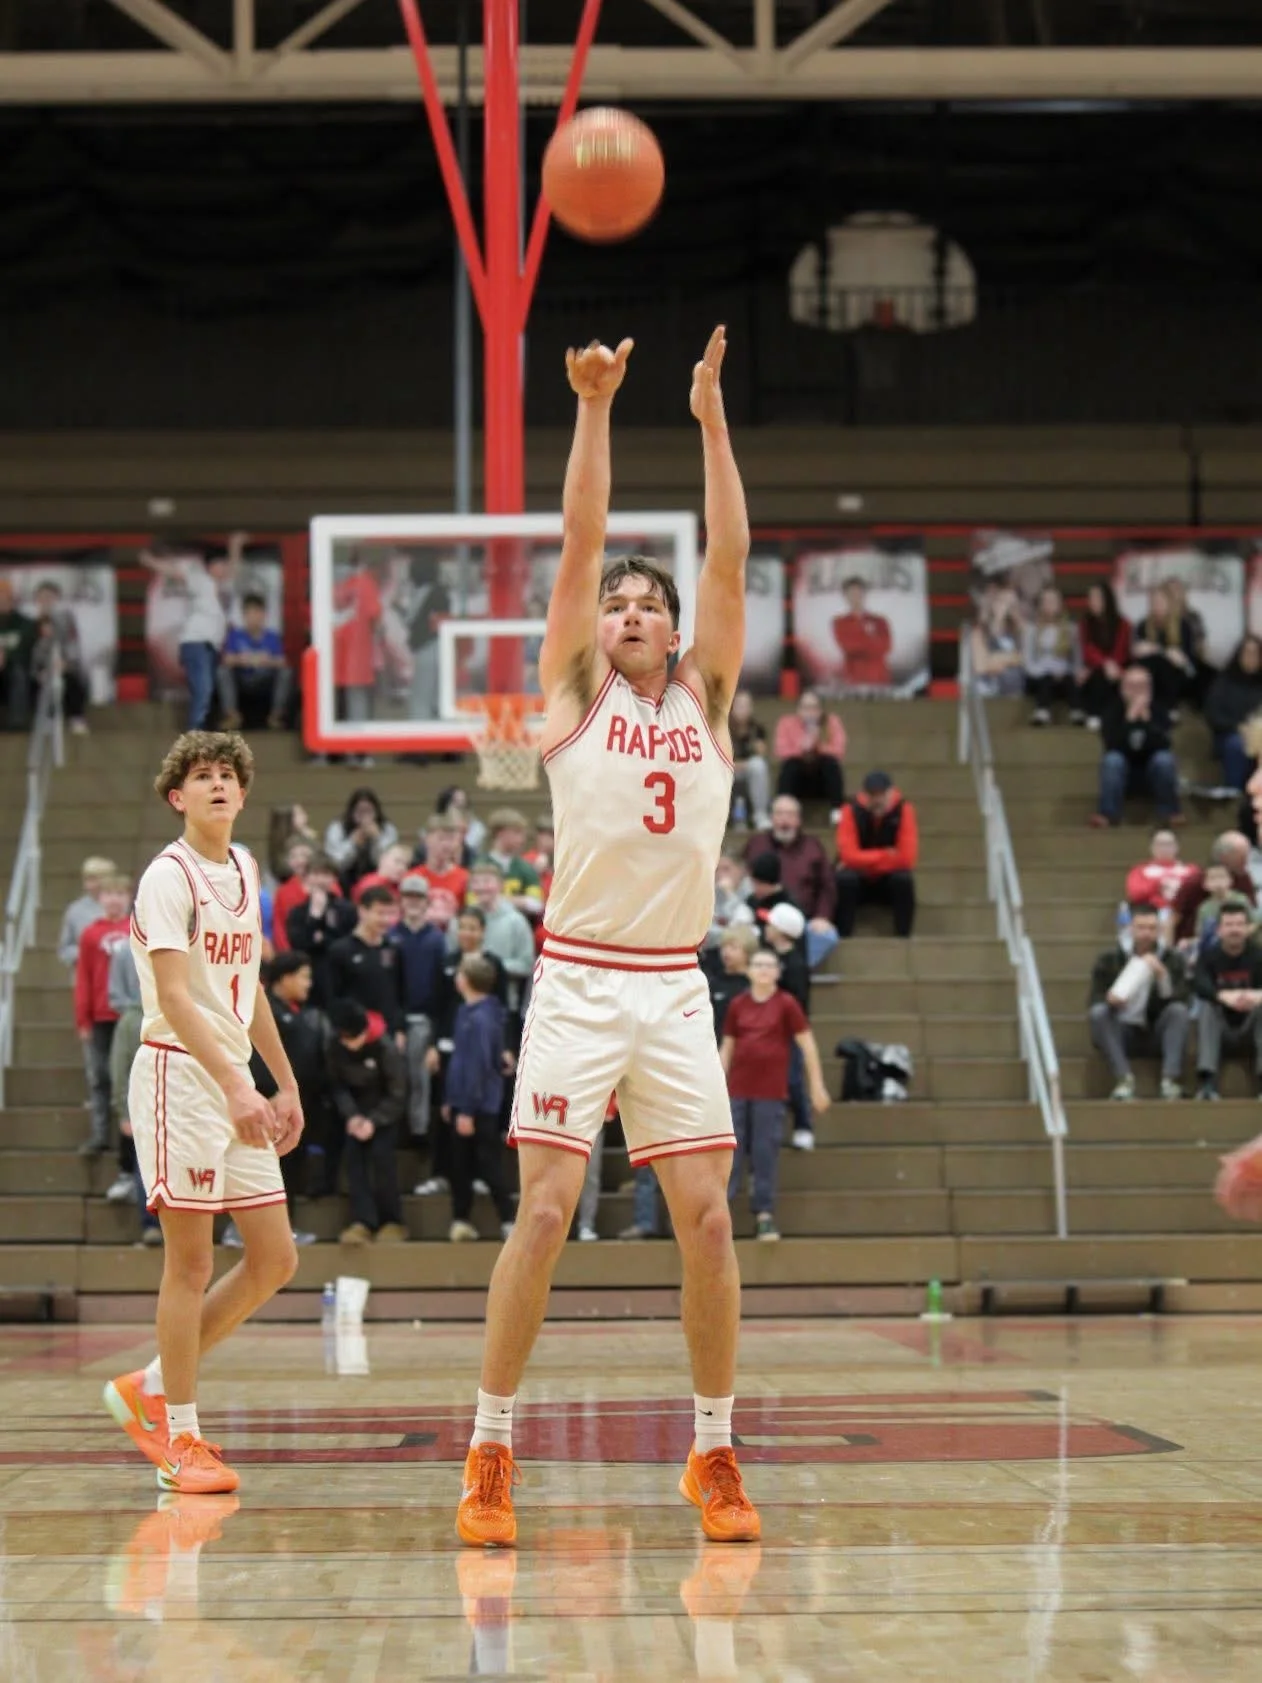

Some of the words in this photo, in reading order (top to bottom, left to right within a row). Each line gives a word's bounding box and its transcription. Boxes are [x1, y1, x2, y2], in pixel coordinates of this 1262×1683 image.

[606, 715, 702, 763] RAPIDS
[643, 771, 675, 834] 3
[230, 973, 244, 1024] 1
